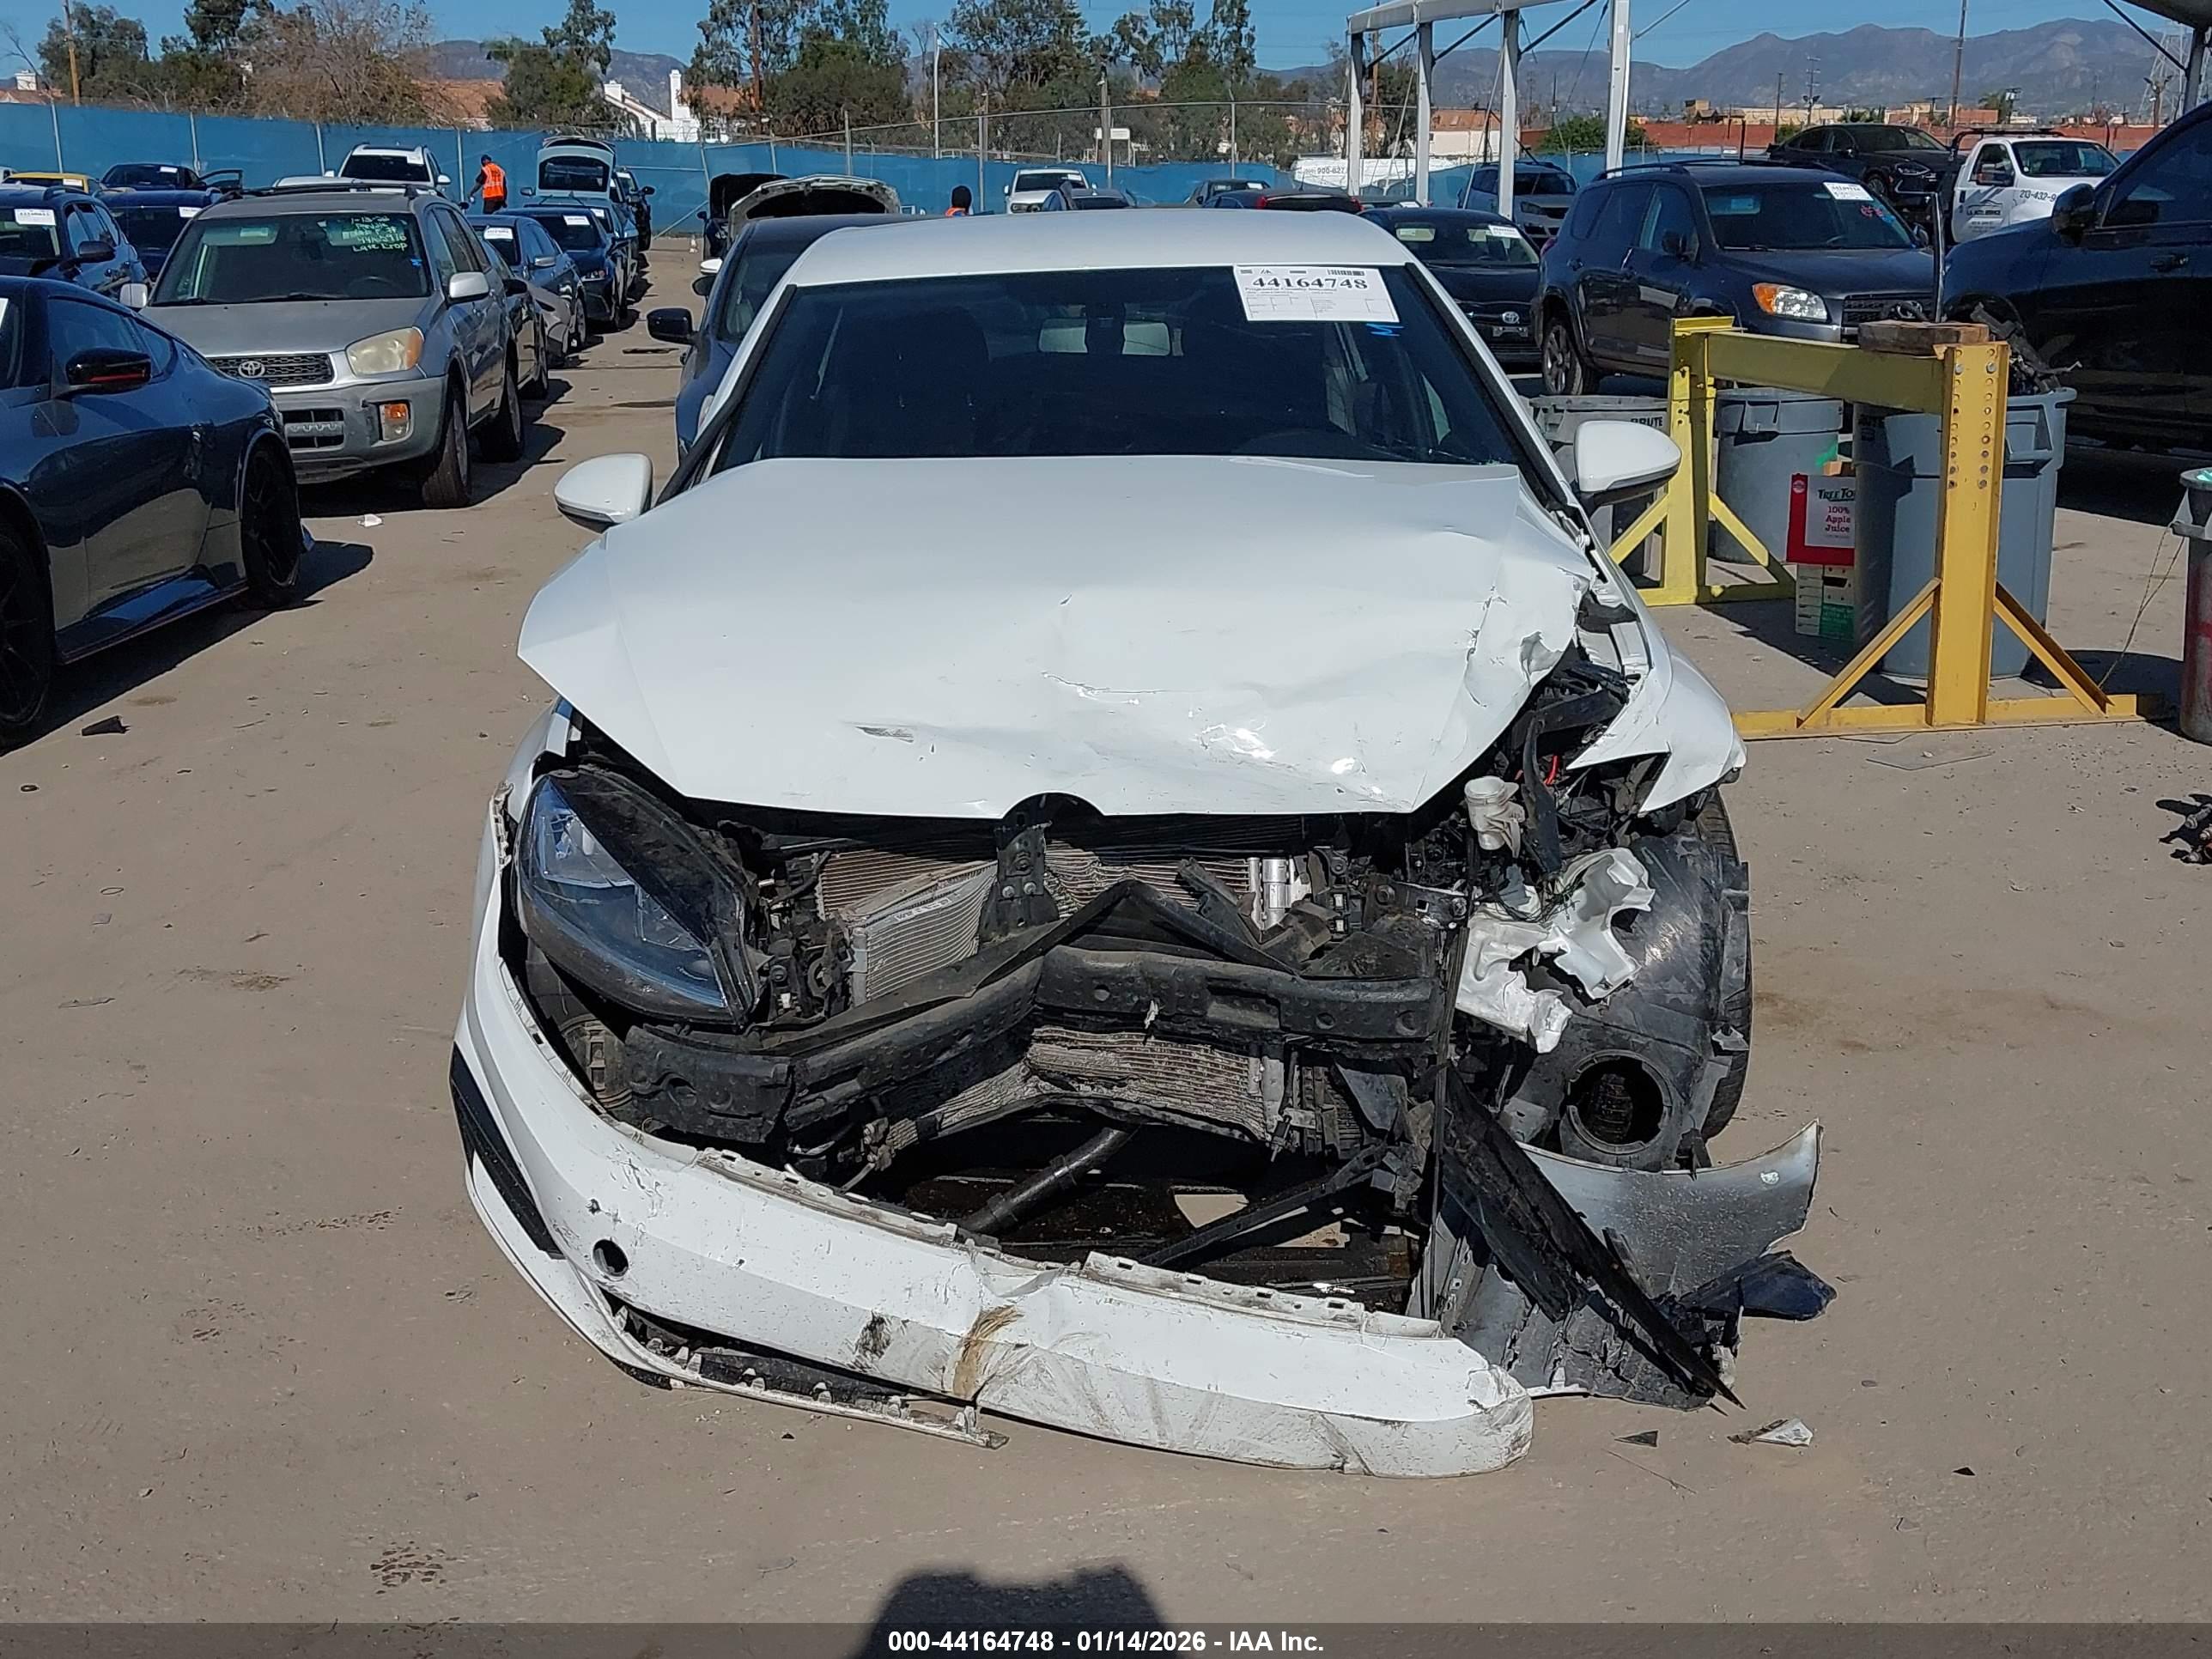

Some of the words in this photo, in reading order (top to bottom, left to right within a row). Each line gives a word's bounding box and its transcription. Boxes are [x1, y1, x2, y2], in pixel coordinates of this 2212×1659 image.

[2020, 189, 2057, 203] 213-432-9
[1253, 276, 1368, 290] 44164748
[1841, 487, 1855, 500] TO
[1827, 505, 1850, 514] 100%
[1825, 514, 1851, 524] Apple
[1825, 524, 1850, 533] Juice
